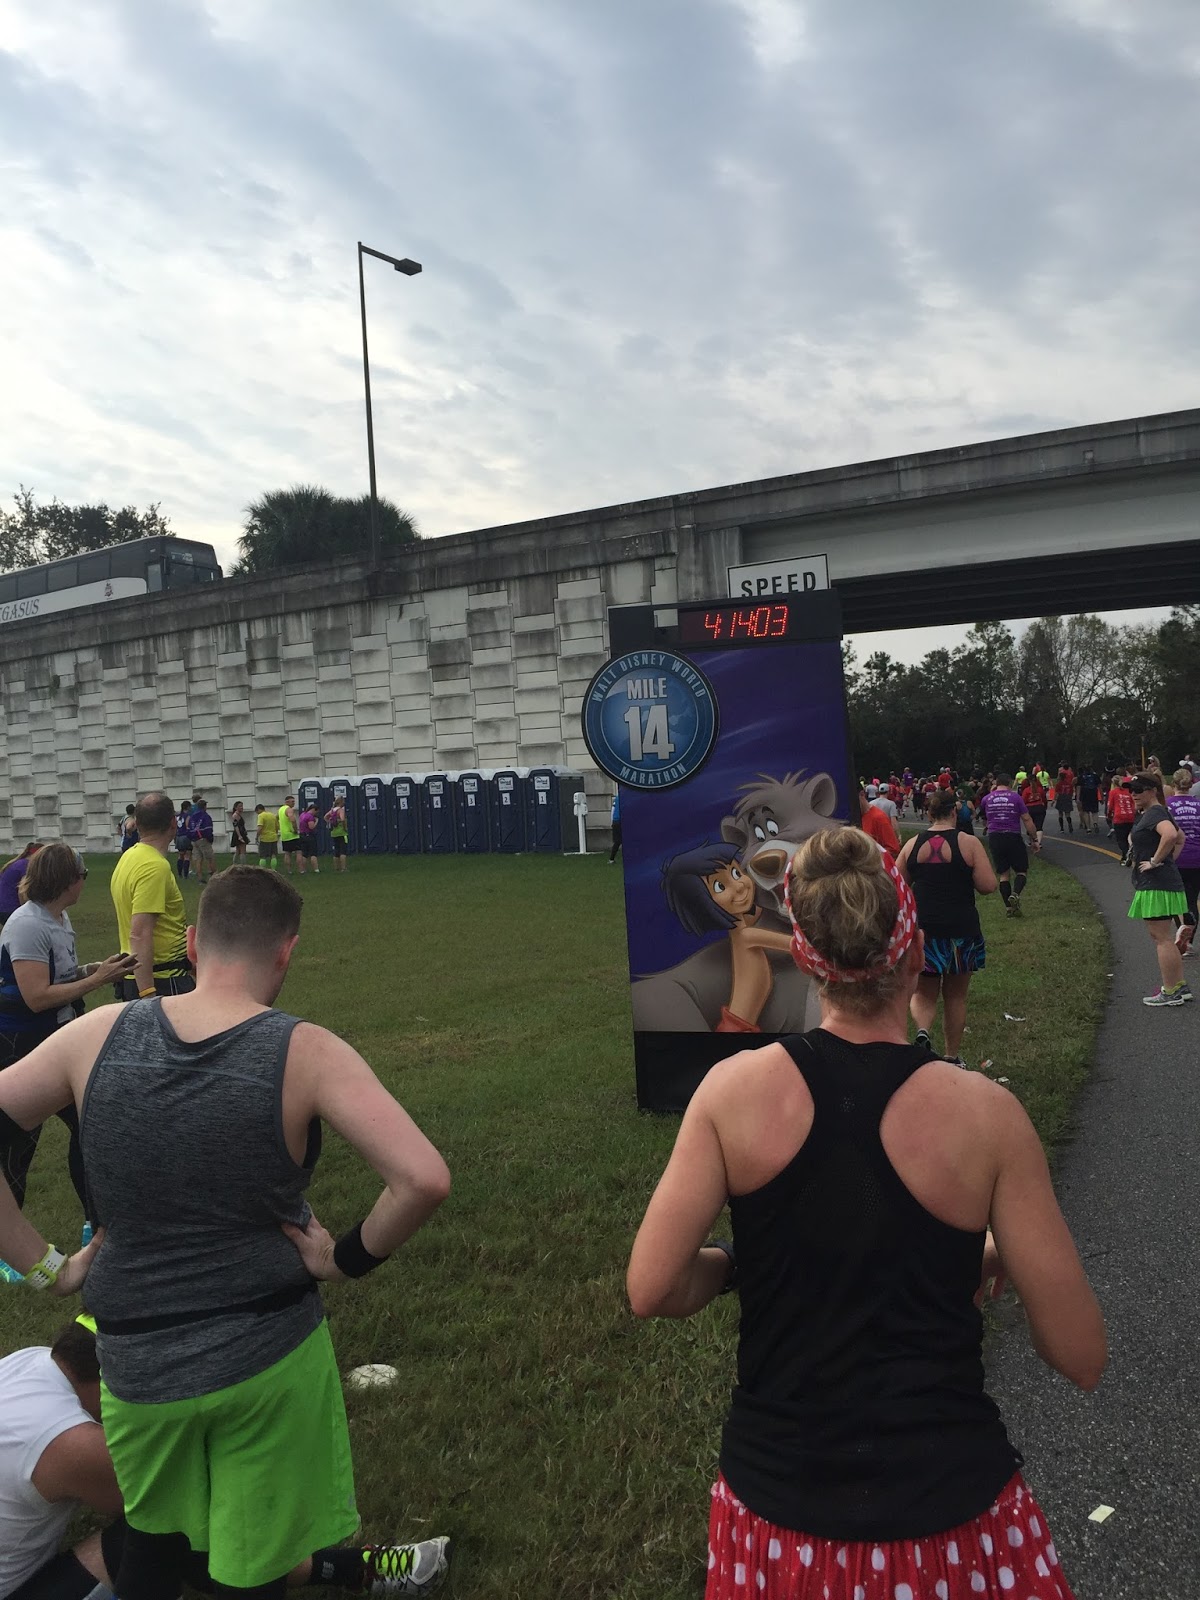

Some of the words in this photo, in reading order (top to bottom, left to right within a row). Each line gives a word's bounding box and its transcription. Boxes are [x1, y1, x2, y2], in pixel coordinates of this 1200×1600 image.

[741, 571, 816, 598] SPEED
[592, 670, 617, 702] WALT
[619, 653, 666, 672] DISNEY
[671, 659, 706, 698] WORLD
[627, 677, 667, 700] MILE
[624, 704, 675, 761] 14
[619, 762, 687, 785] MARATHON
